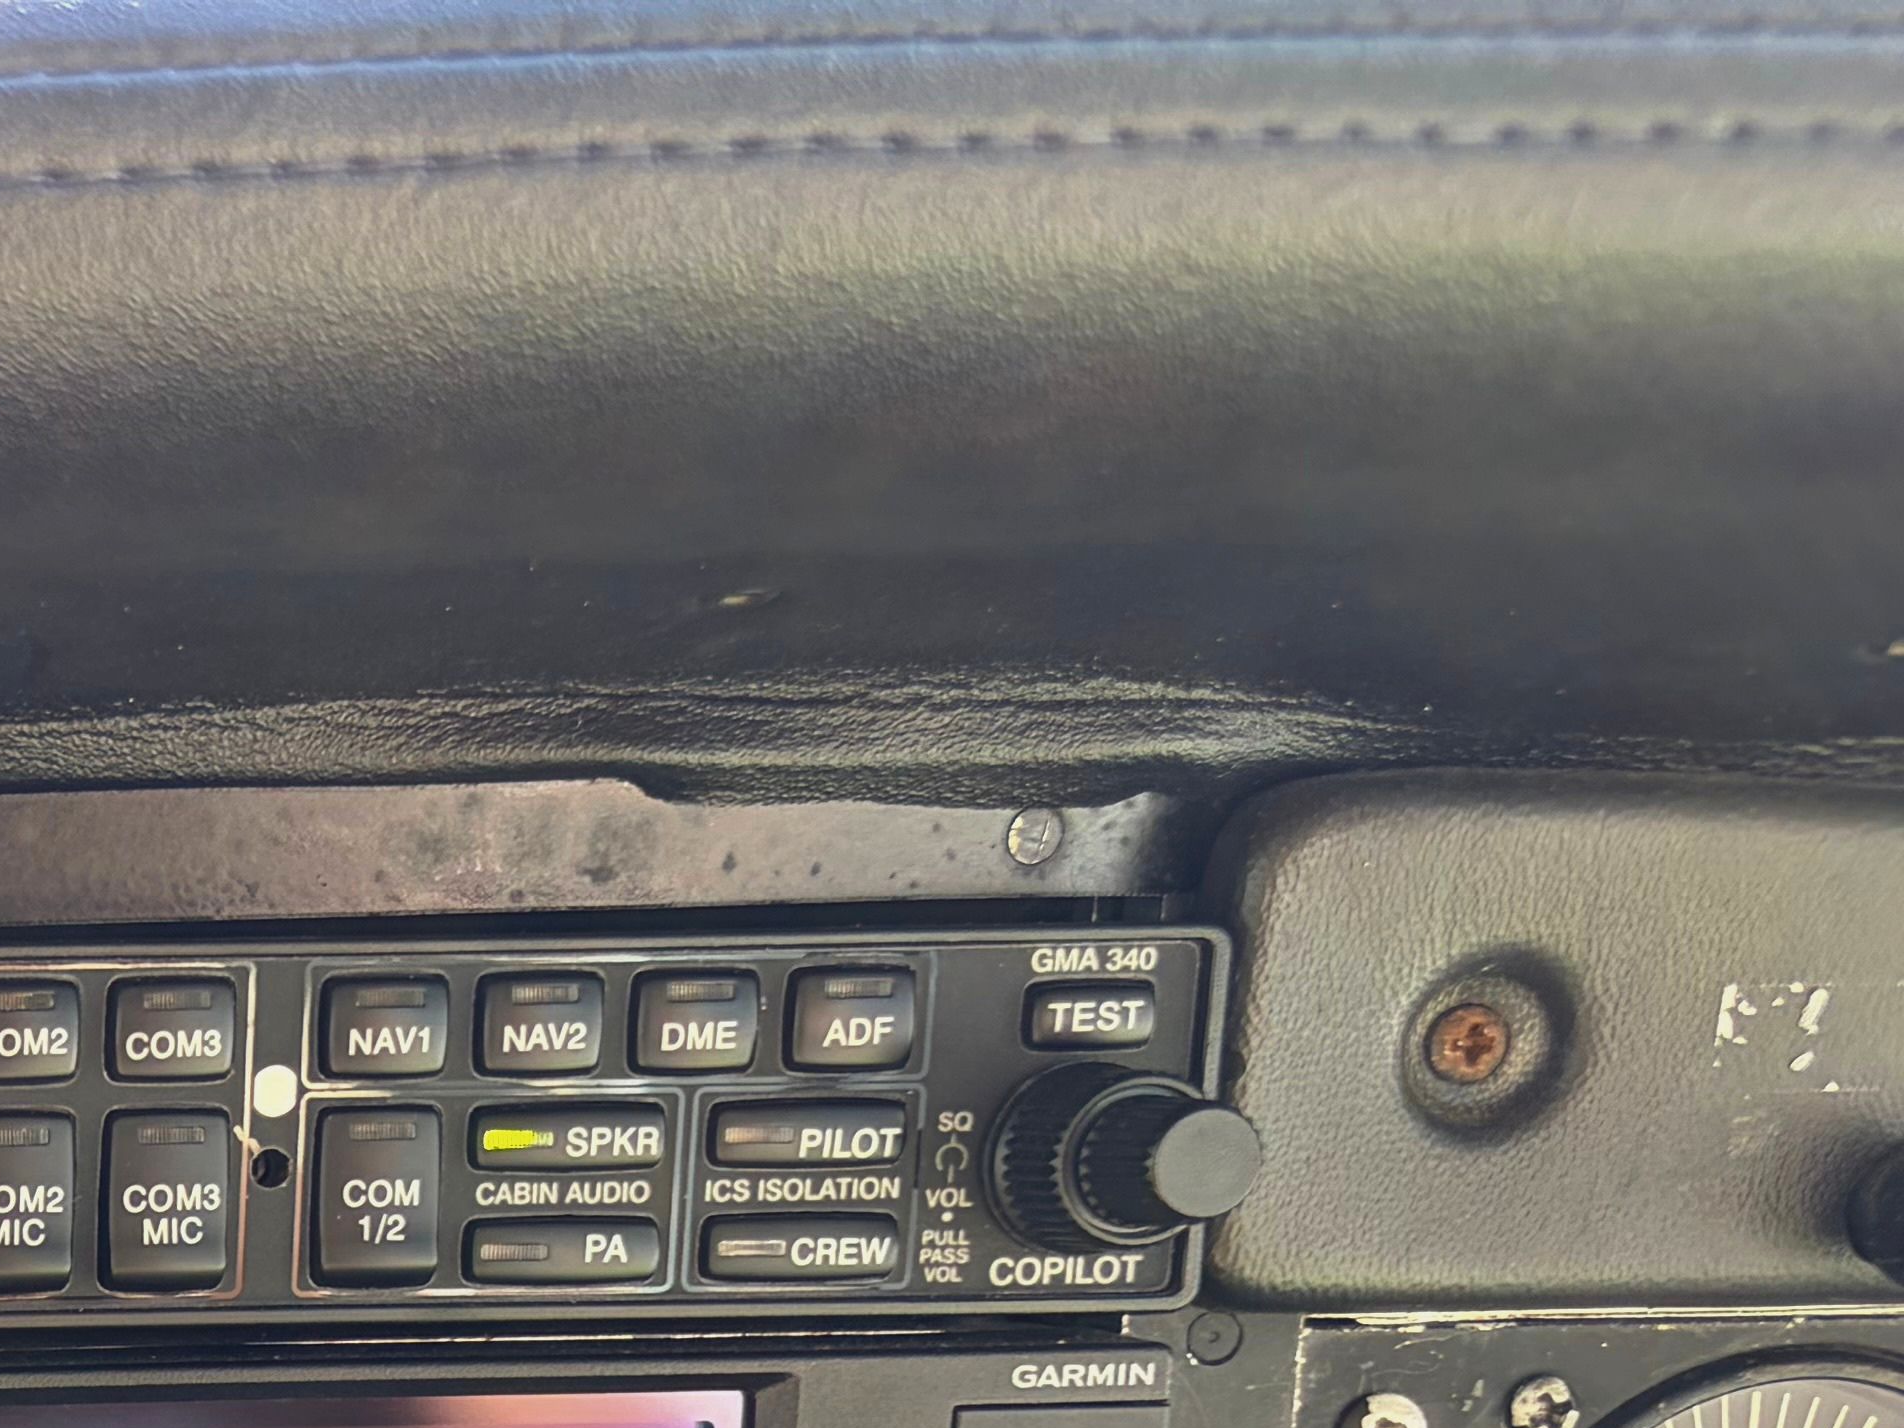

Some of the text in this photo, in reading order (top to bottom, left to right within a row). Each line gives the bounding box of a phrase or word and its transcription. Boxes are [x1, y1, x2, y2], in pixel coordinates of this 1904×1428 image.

[1030, 944, 1158, 975] GMA 340
[823, 1016, 894, 1048] ADF
[1048, 1000, 1143, 1033] TEST
[124, 1030, 223, 1061] COM3
[348, 1026, 431, 1058] NAV1
[502, 1023, 587, 1054] NAV2
[660, 1021, 738, 1052] DME
[474, 1178, 651, 1207] CABIN AUDIO
[704, 1175, 901, 1202] ICS ISOLATION
[988, 1255, 1142, 1287] COPILOT
[1012, 1363, 1156, 1389] GARMIN
